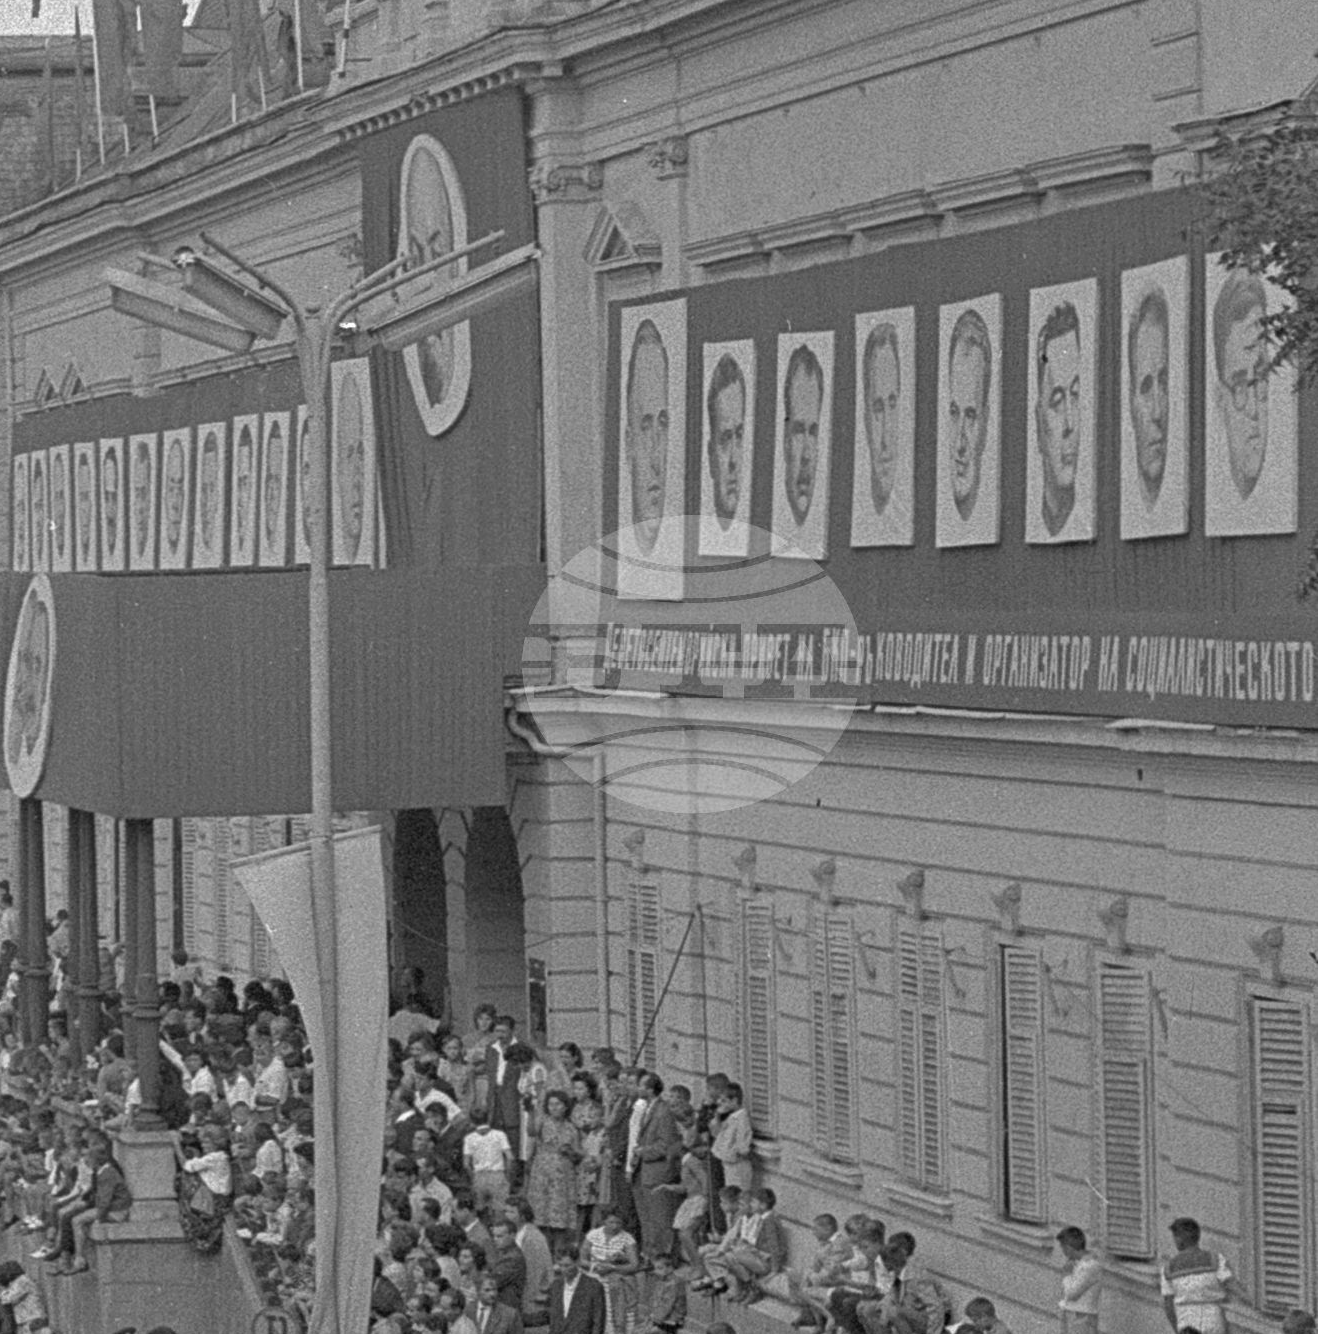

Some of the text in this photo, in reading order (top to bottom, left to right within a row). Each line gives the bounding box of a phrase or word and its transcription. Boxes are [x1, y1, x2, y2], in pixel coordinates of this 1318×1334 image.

[741, 632, 791, 681] ПРИВЕТ
[796, 633, 814, 681] НА
[965, 634, 978, 685] И
[983, 634, 1091, 691] ОРГАНИЗАТОР
[1098, 635, 1120, 692] НА
[1126, 635, 1313, 701] СОЦИАЛИСТИЧЕСКОТО
